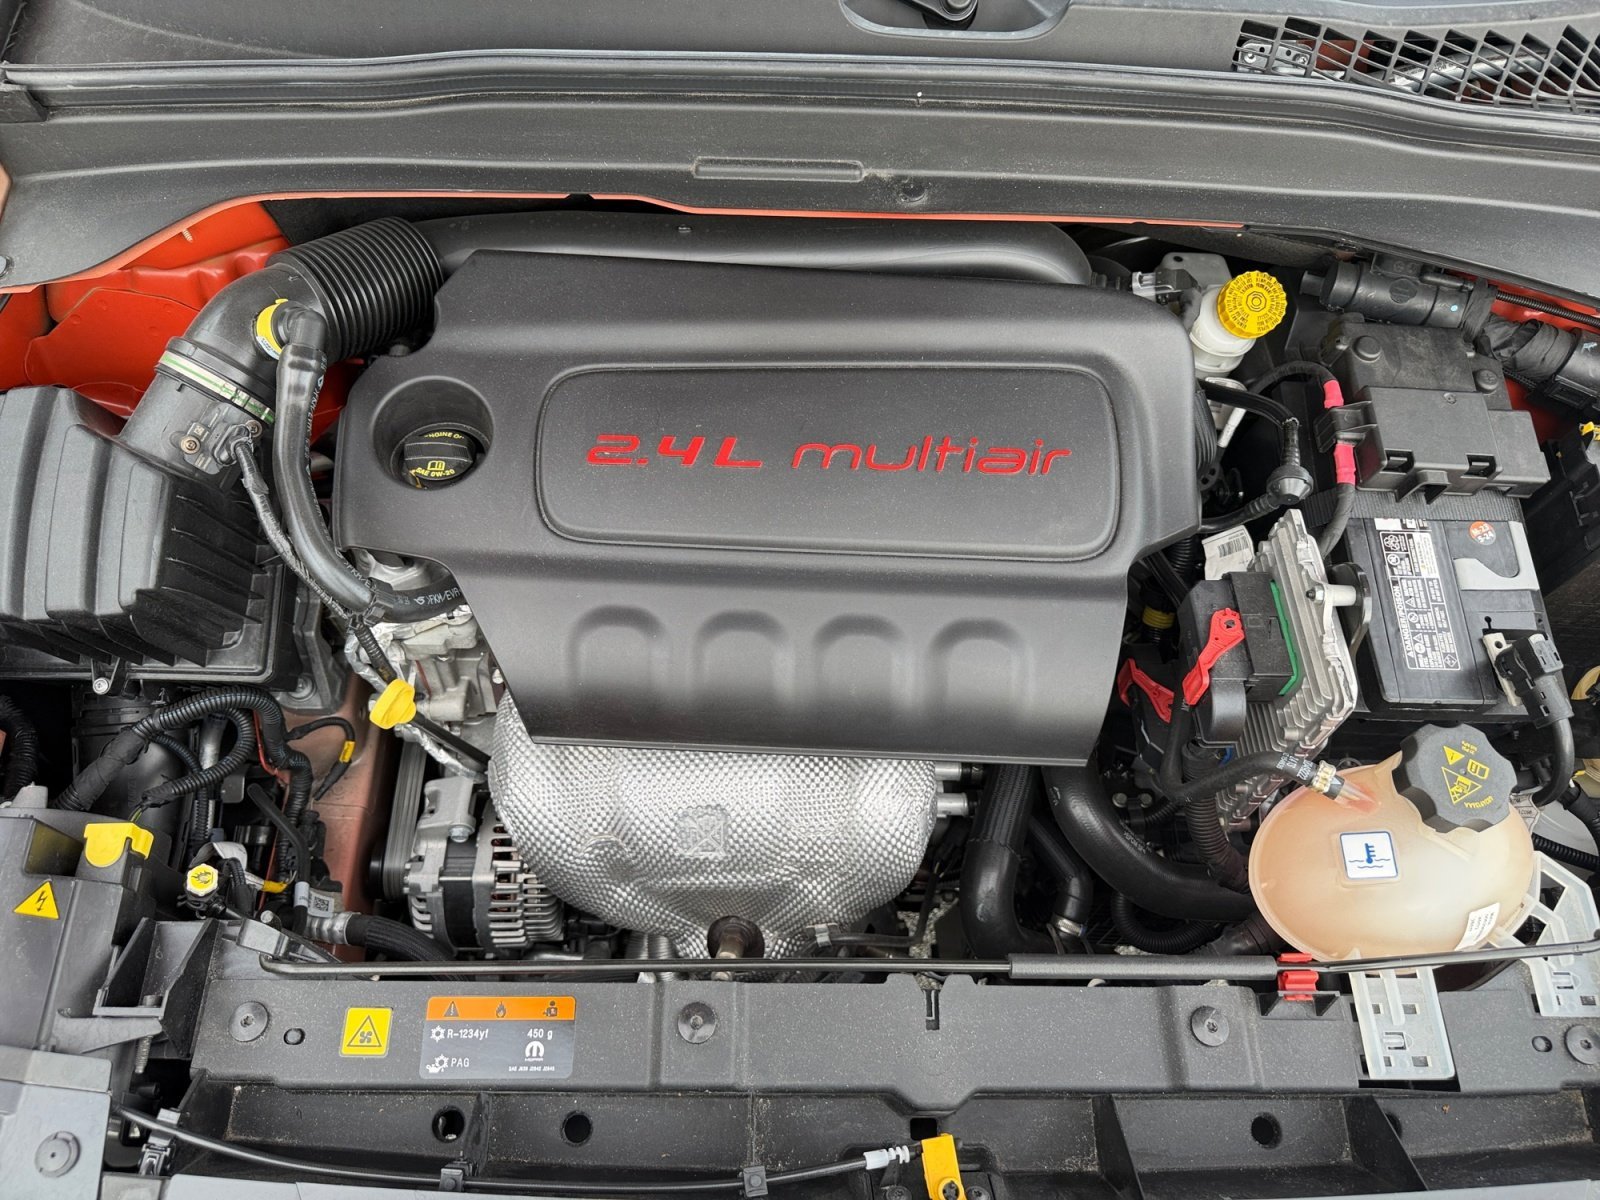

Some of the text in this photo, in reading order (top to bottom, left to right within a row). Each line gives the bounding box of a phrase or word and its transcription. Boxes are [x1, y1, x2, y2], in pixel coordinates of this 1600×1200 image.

[792, 435, 1072, 476] multiair
[447, 1028, 553, 1040] R-1234yf 450 g
[451, 1057, 470, 1068] PAG
